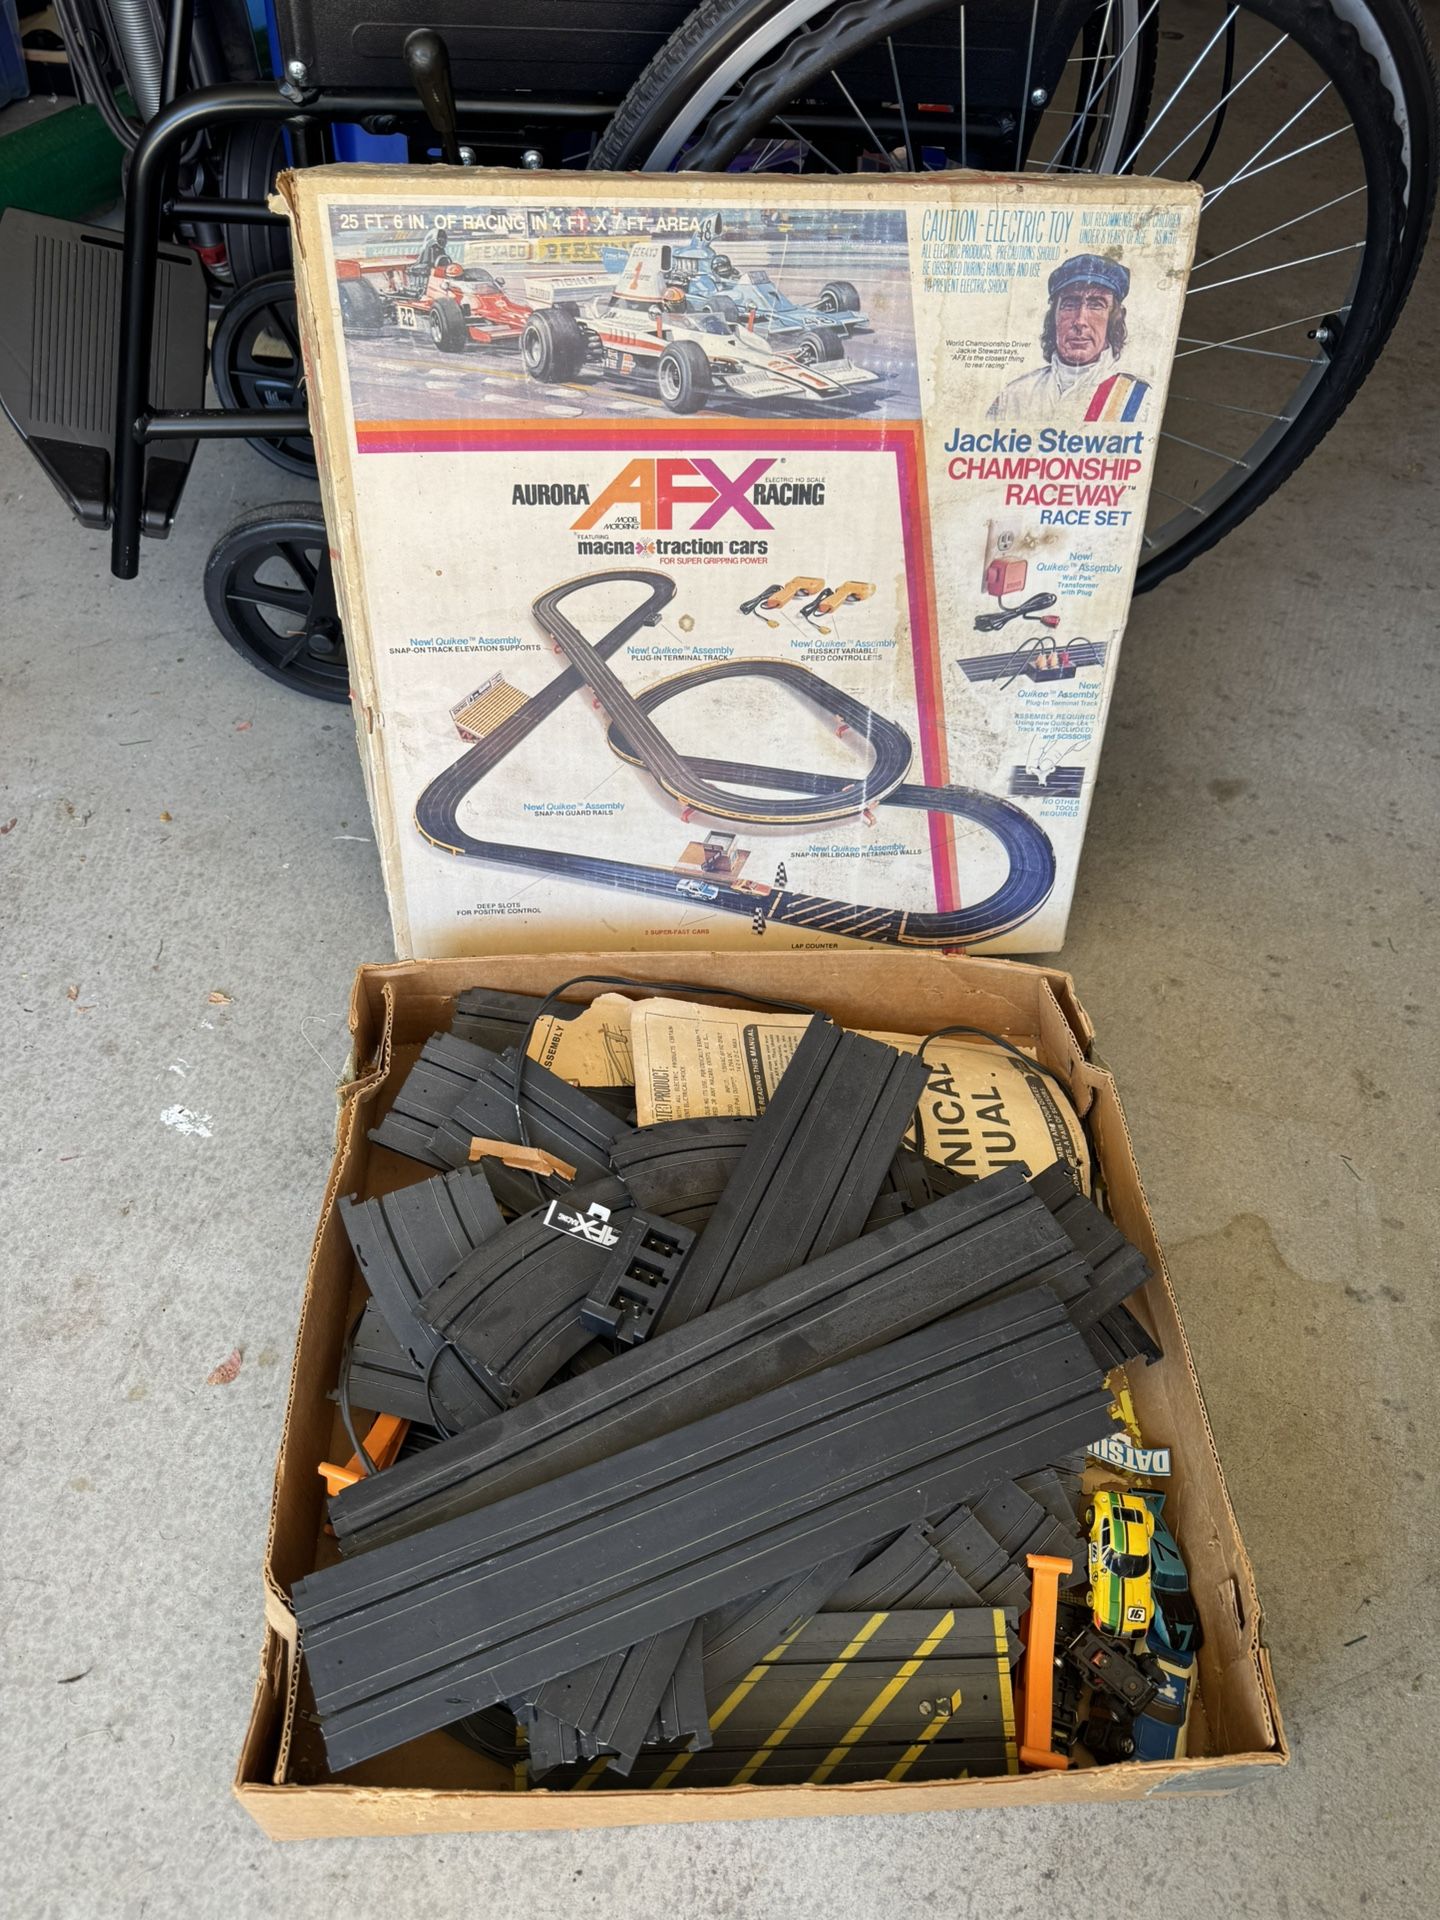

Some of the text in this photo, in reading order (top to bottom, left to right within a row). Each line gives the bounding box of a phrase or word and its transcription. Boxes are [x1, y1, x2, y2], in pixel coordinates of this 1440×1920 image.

[340, 214, 701, 232] 25 FT. 6 IN. OF RACING IN 4 FT. X 7 FT. AREA
[921, 209, 977, 242] CAUTION
[1050, 210, 1074, 243] TOY
[472, 244, 526, 259] TEXACO
[921, 244, 931, 258] ALL
[932, 244, 960, 259] ELECTRIC
[996, 245, 1036, 260] PRECAUTIONS
[1037, 245, 1060, 260] SHOULD
[922, 260, 1041, 277] BE OBSERVED DURING HANDLING AND USE
[924, 278, 932, 292] TO
[932, 278, 960, 293] PREVENT
[960, 279, 987, 293] ELECTRIC
[400, 308, 414, 326] 22
[945, 339, 1032, 348] World Championship Driver
[956, 347, 977, 355] Jackie
[978, 347, 1003, 355] Stewart
[944, 427, 1145, 454] Jackie Stewart
[947, 456, 1143, 481] CHAMPIONSHIP
[512, 483, 826, 506] AURORA RACING
[614, 516, 639, 524] MODEL
[1039, 509, 1132, 527] RACE SET
[603, 523, 640, 531] MOTORING
[577, 538, 768, 556] magna traction cars
[659, 557, 768, 565] FOR SUPER GRIPPING POWER
[1078, 563, 1122, 573] Assembly
[1057, 581, 1099, 589] Transformer
[1077, 589, 1092, 597] Plug
[410, 637, 434, 647] New!
[478, 636, 522, 647] Assembly
[790, 639, 814, 648] New!
[855, 638, 897, 649] Assembly
[389, 647, 426, 655] SNAP-ON
[499, 644, 542, 652] SUPPORTS
[627, 645, 650, 655] New!
[692, 645, 734, 656] Assembly
[807, 647, 879, 655] RUSSKIT VARIABLE
[826, 654, 883, 662] CONTROLLERS
[1057, 690, 1100, 700] Assembly
[1036, 726, 1049, 734] Key
[523, 802, 546, 811] New!
[585, 801, 625, 812] Assembly
[808, 844, 830, 853] New!
[868, 842, 907, 852] Assembly
[861, 850, 899, 858] RETAINING
[473, 908, 506, 916] POSITIVE
[506, 907, 542, 915] CONTROL
[650, 928, 690, 936] SUPER-FAST
[806, 942, 838, 950] COUNTER
[543, 1024, 565, 1070] SSEMBLY
[746, 1028, 757, 1057] MANUAL
[751, 1058, 760, 1073] THIS
[754, 1074, 766, 1105] READING
[1040, 1087, 1068, 1139] PAIR SCISSORS
[927, 1061, 978, 1180] NICAL
[1041, 1106, 1064, 1160] MBLY ARE YOUR
[568, 1211, 620, 1246] AFX
[1129, 1608, 1143, 1619] 16
[1175, 1622, 1194, 1651] 7
